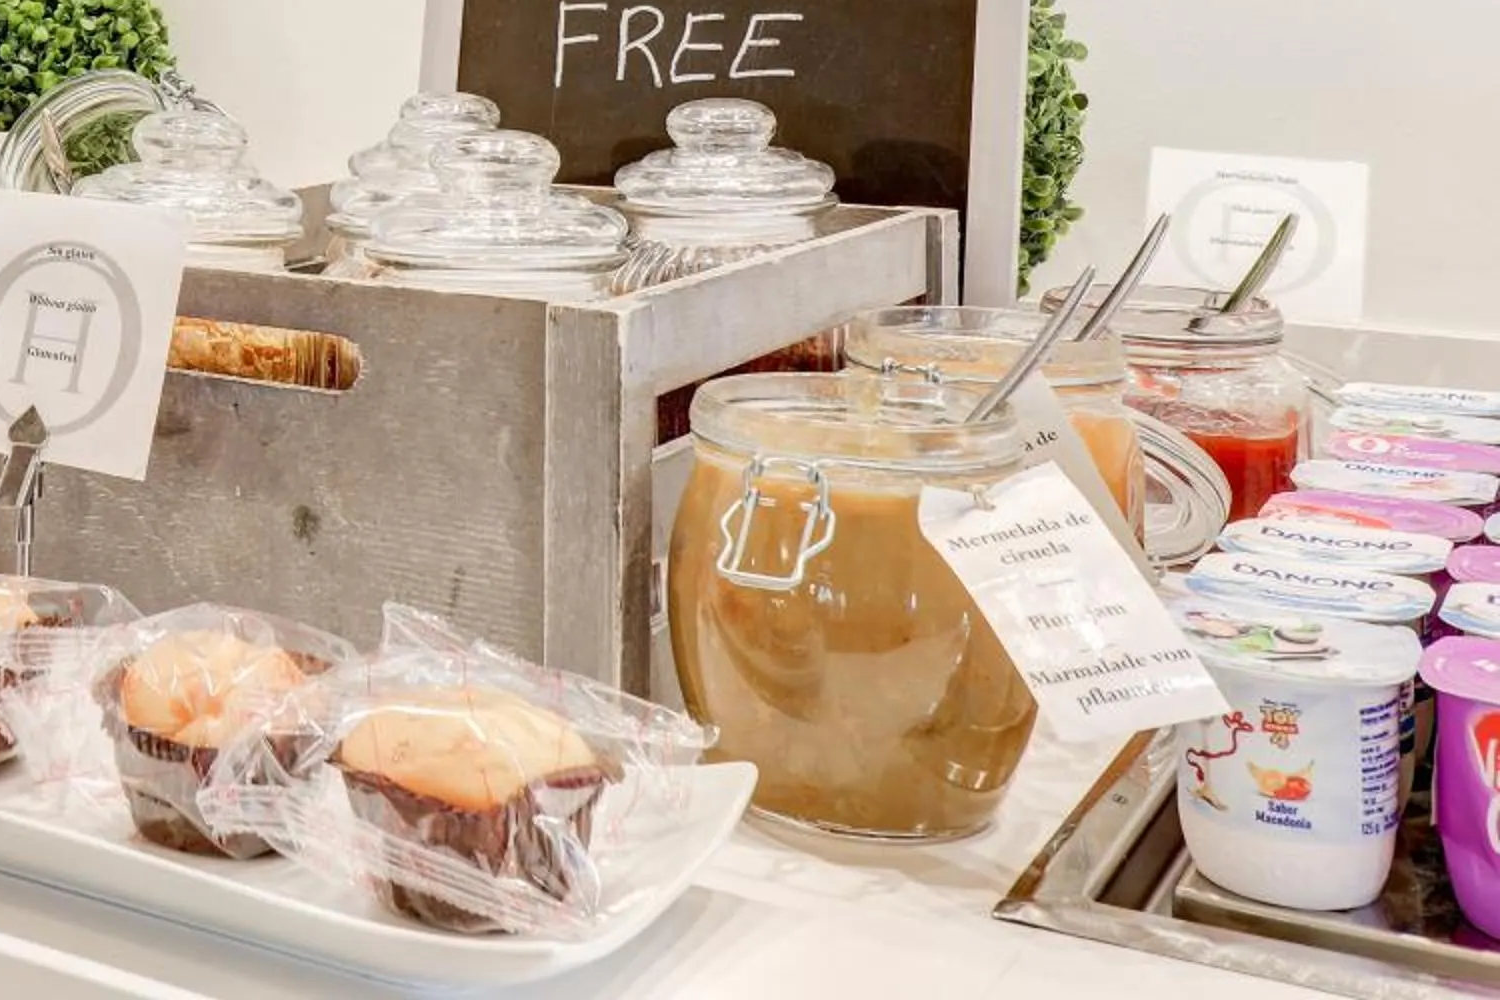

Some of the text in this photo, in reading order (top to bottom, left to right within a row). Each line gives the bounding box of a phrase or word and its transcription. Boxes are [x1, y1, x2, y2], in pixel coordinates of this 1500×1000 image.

[553, 1, 804, 89] FREE
[947, 510, 1091, 553] Mermelada de
[1259, 525, 1413, 550] DANONE
[999, 540, 1072, 566] ciruela
[1231, 562, 1395, 591] DANONE
[1029, 647, 1192, 689] Marmalade von
